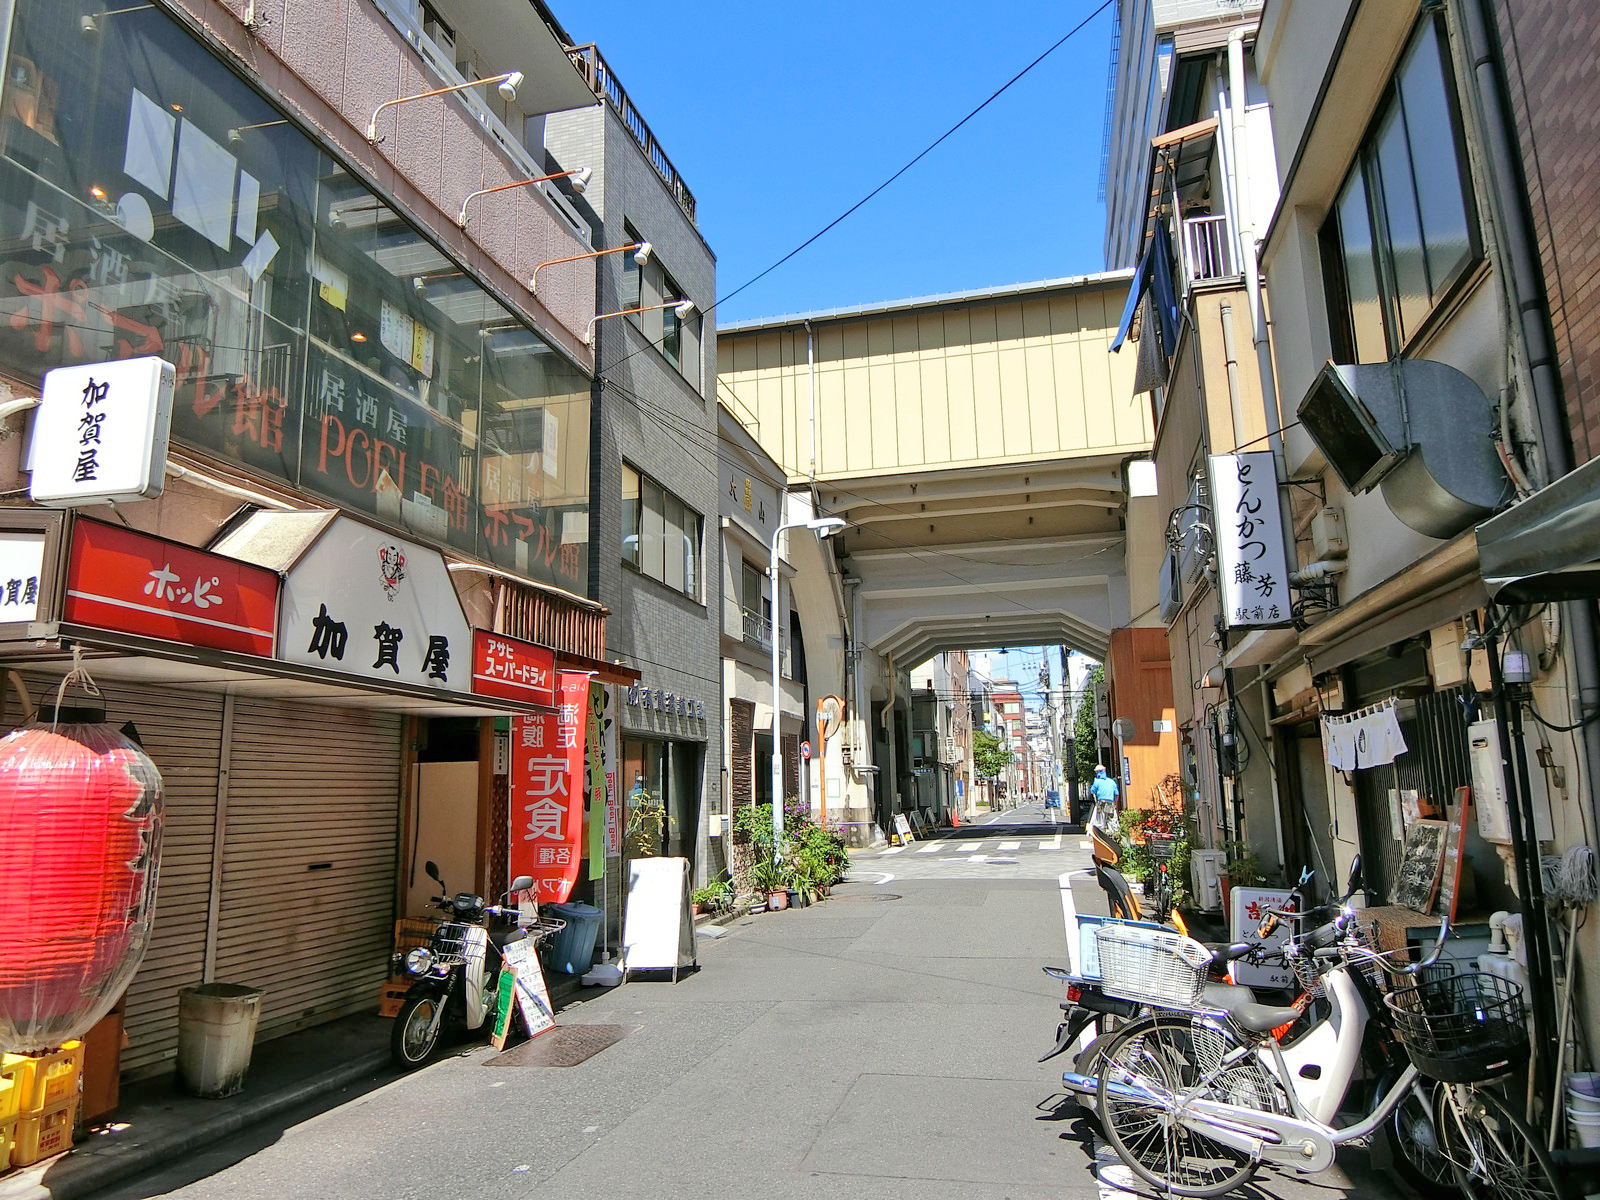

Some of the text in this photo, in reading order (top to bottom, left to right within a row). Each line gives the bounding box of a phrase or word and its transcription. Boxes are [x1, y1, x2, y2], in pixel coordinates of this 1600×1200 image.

[71, 376, 110, 483] 加賀屋
[320, 368, 409, 446] 居酒屋
[486, 462, 540, 516] 居酒屋
[1236, 460, 1267, 561] とんかつ
[144, 562, 224, 609] ホッピー
[1234, 560, 1278, 598] 藤芳
[1235, 605, 1280, 621] 駅前店
[307, 602, 450, 683] 加賀屋
[487, 638, 514, 660] アサヒ
[485, 656, 547, 686] スーパードライ
[1242, 929, 1279, 939] とんつ
